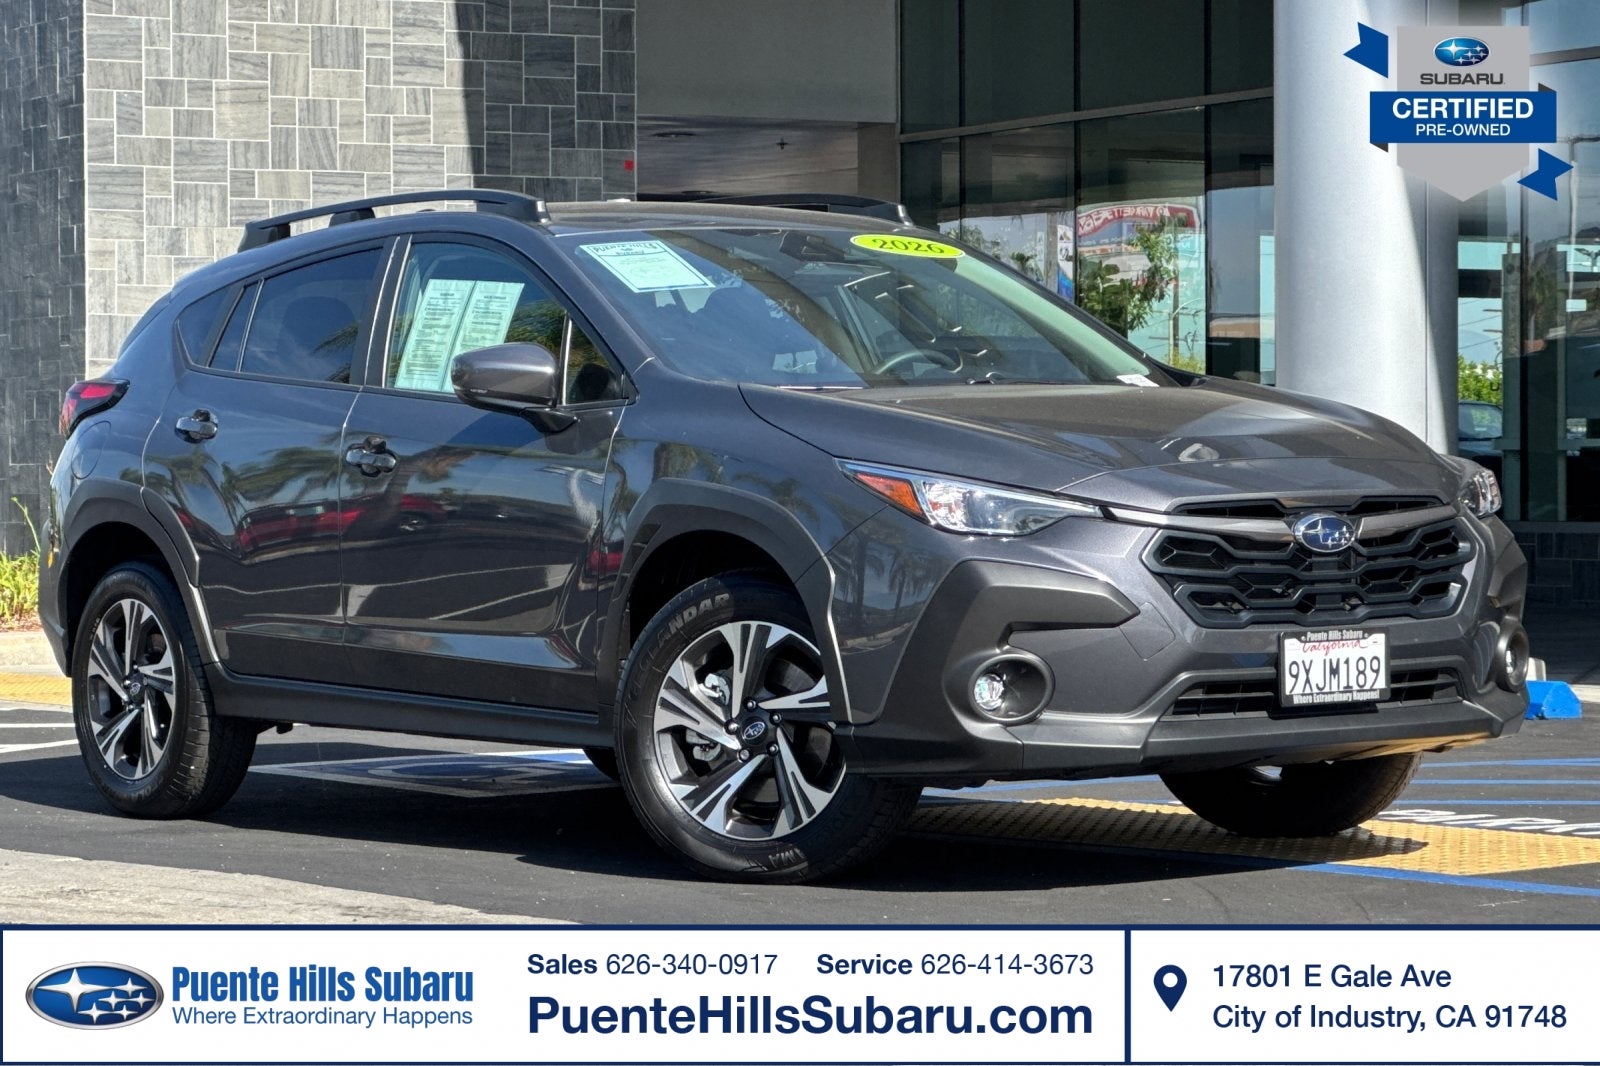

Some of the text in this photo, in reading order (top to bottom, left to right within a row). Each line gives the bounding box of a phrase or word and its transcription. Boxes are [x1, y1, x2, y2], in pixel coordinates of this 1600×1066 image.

[872, 238, 945, 254] 2026
[1306, 629, 1363, 642] Puente Hills Subaru
[1302, 640, 1361, 657] California
[1288, 655, 1381, 694] 9XJM189
[1293, 693, 1313, 705] Where
[1313, 691, 1352, 703] Extraordinary
